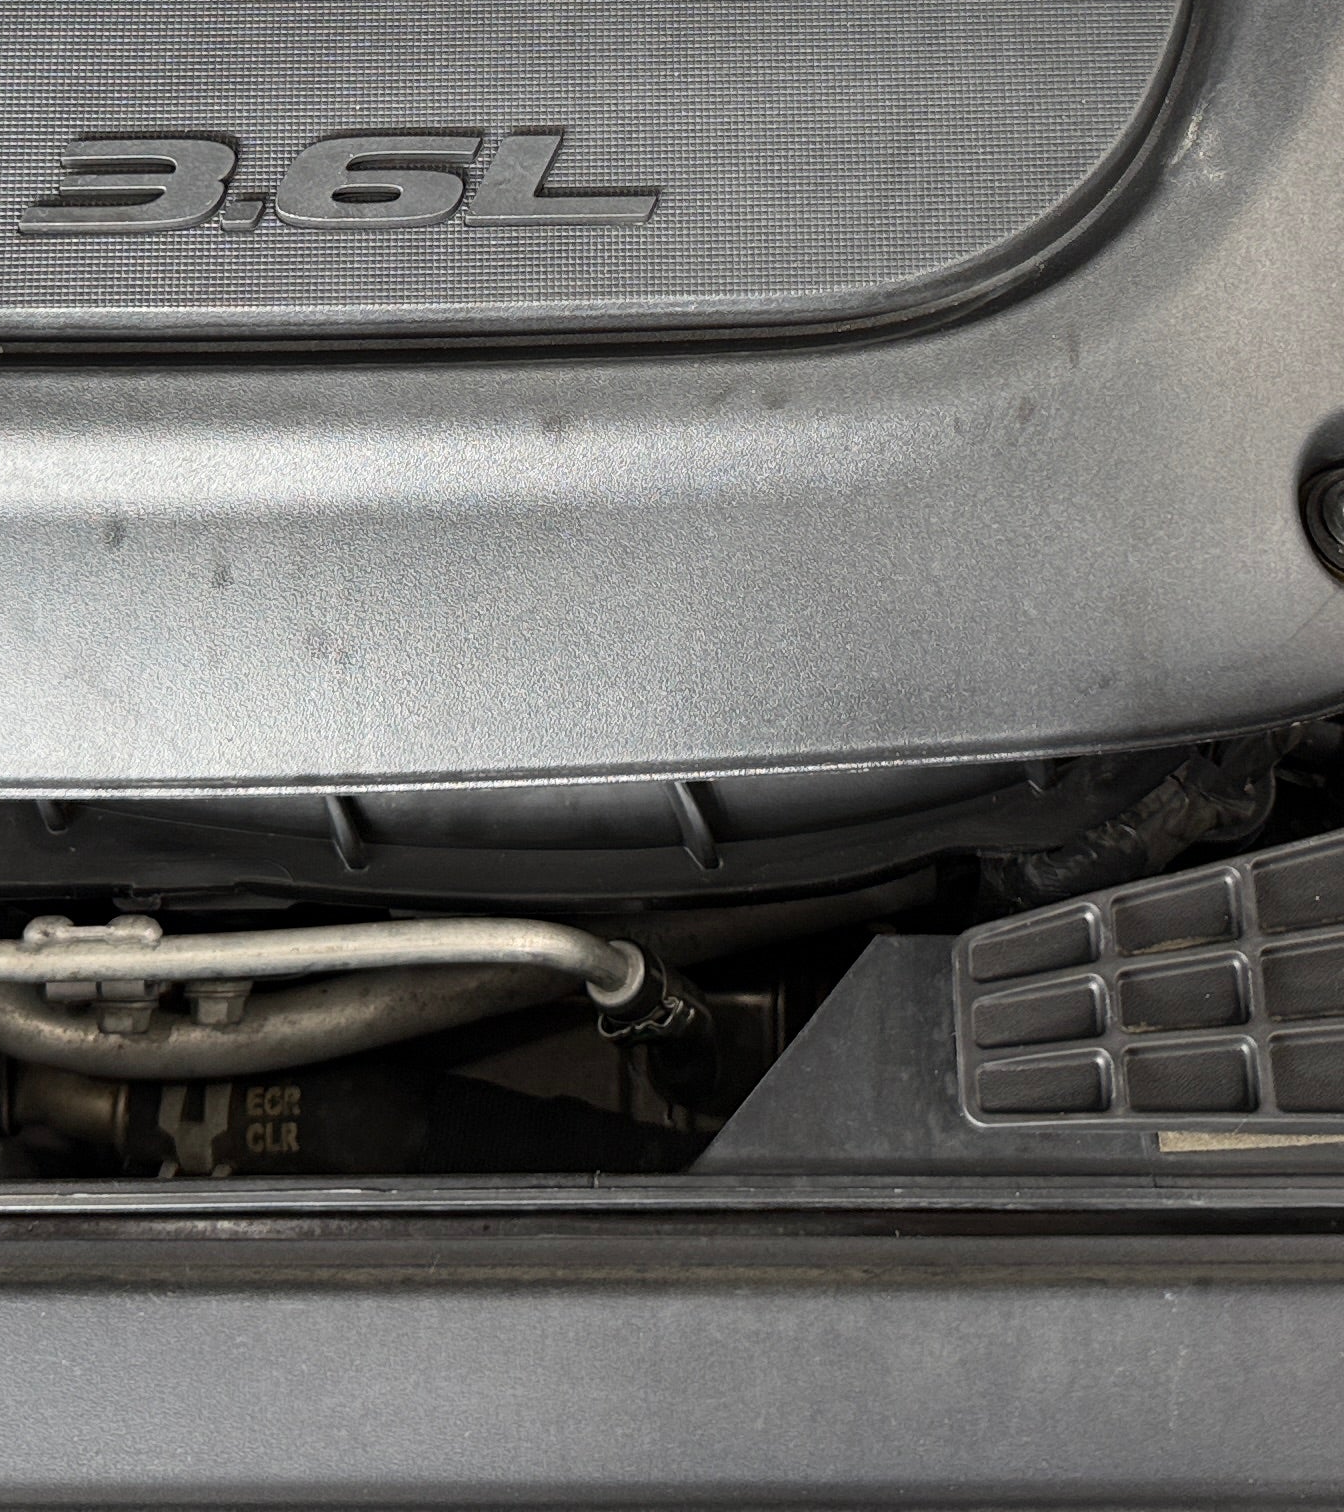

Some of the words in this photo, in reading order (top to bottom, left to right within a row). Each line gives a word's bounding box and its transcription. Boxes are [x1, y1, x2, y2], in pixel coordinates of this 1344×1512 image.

[17, 125, 662, 236] 3.6L
[245, 1085, 302, 1117] EGR
[245, 1120, 302, 1154] CLR
